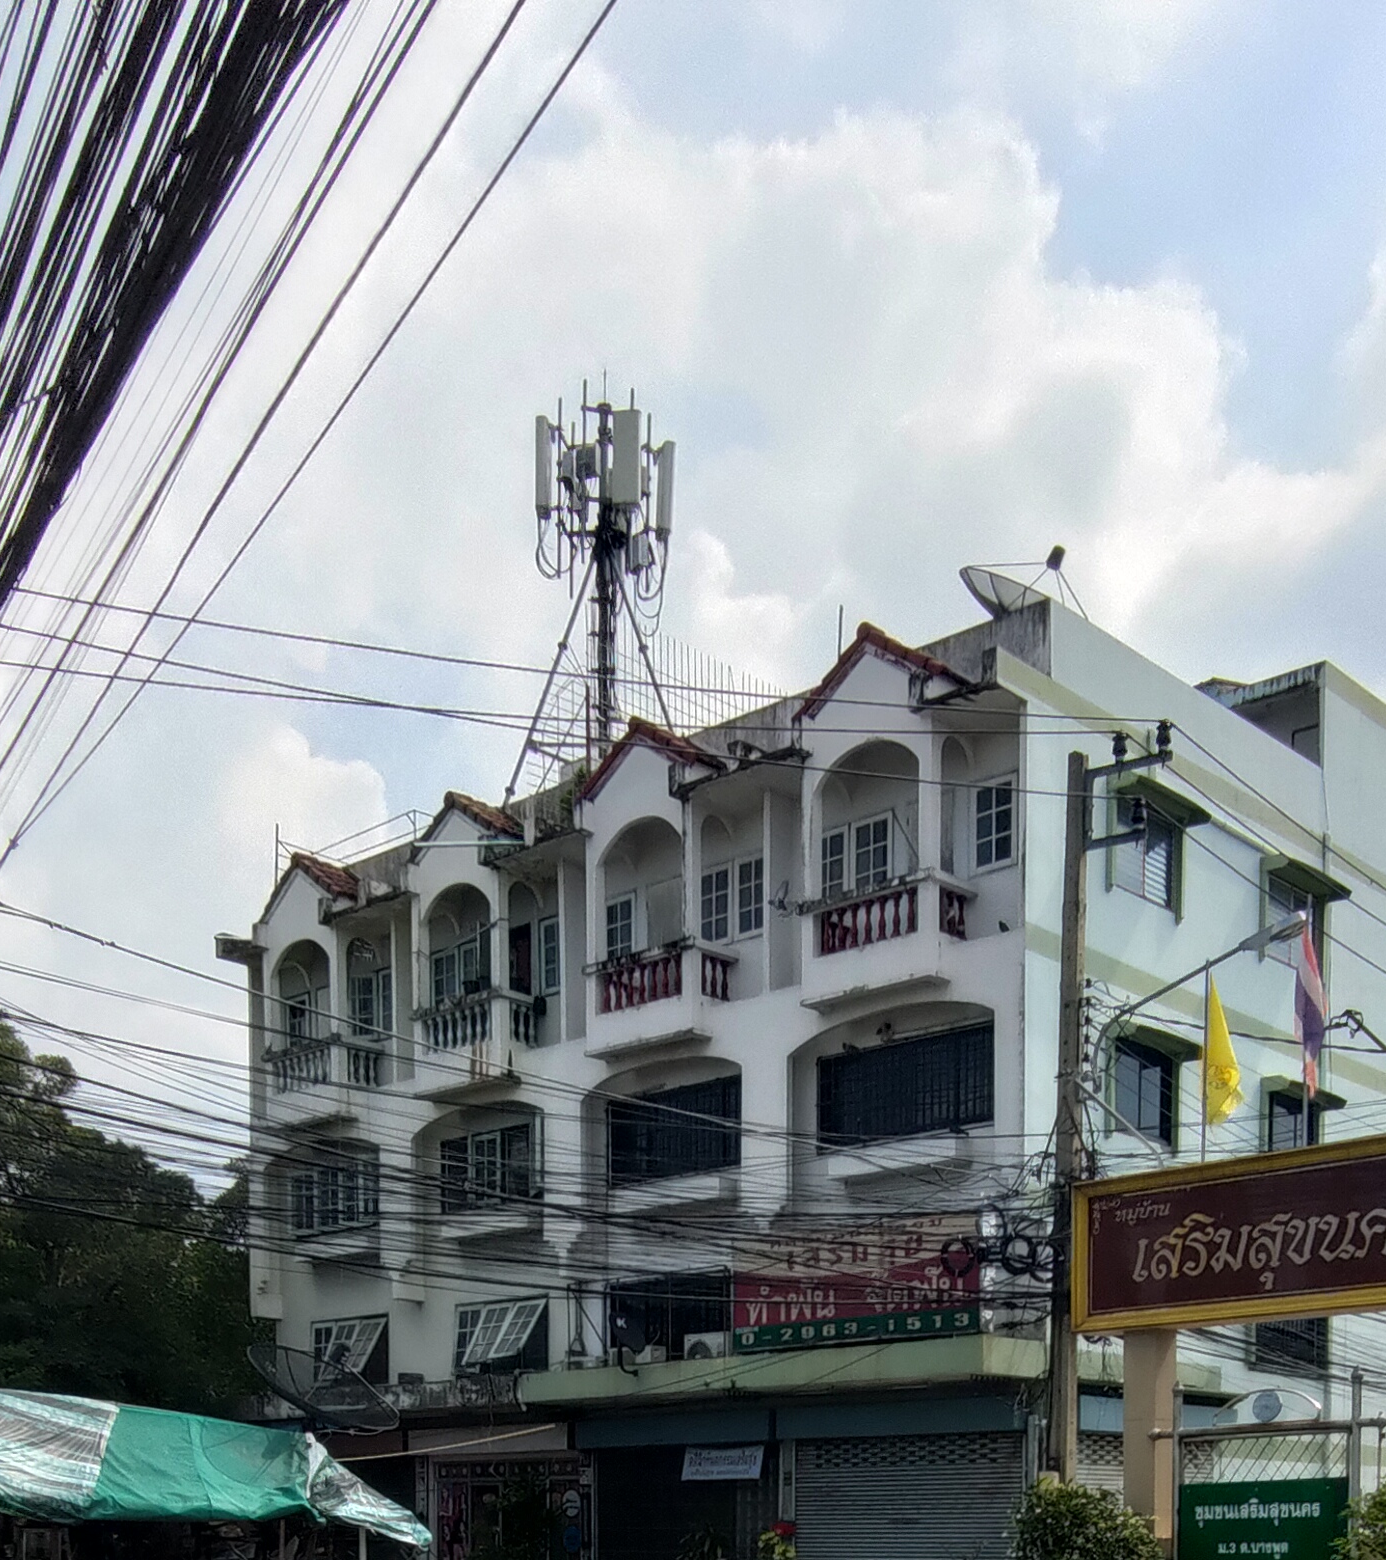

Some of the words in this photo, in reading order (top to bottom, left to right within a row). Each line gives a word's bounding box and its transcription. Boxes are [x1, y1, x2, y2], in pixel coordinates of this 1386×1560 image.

[1114, 1200, 1170, 1226] หมู่บ้าน
[1194, 1498, 1321, 1528] ชุมชนเสริมสุขนคร
[1217, 1542, 1236, 1554] ม.3
[1239, 1542, 1289, 1560] ต.บางพูด
